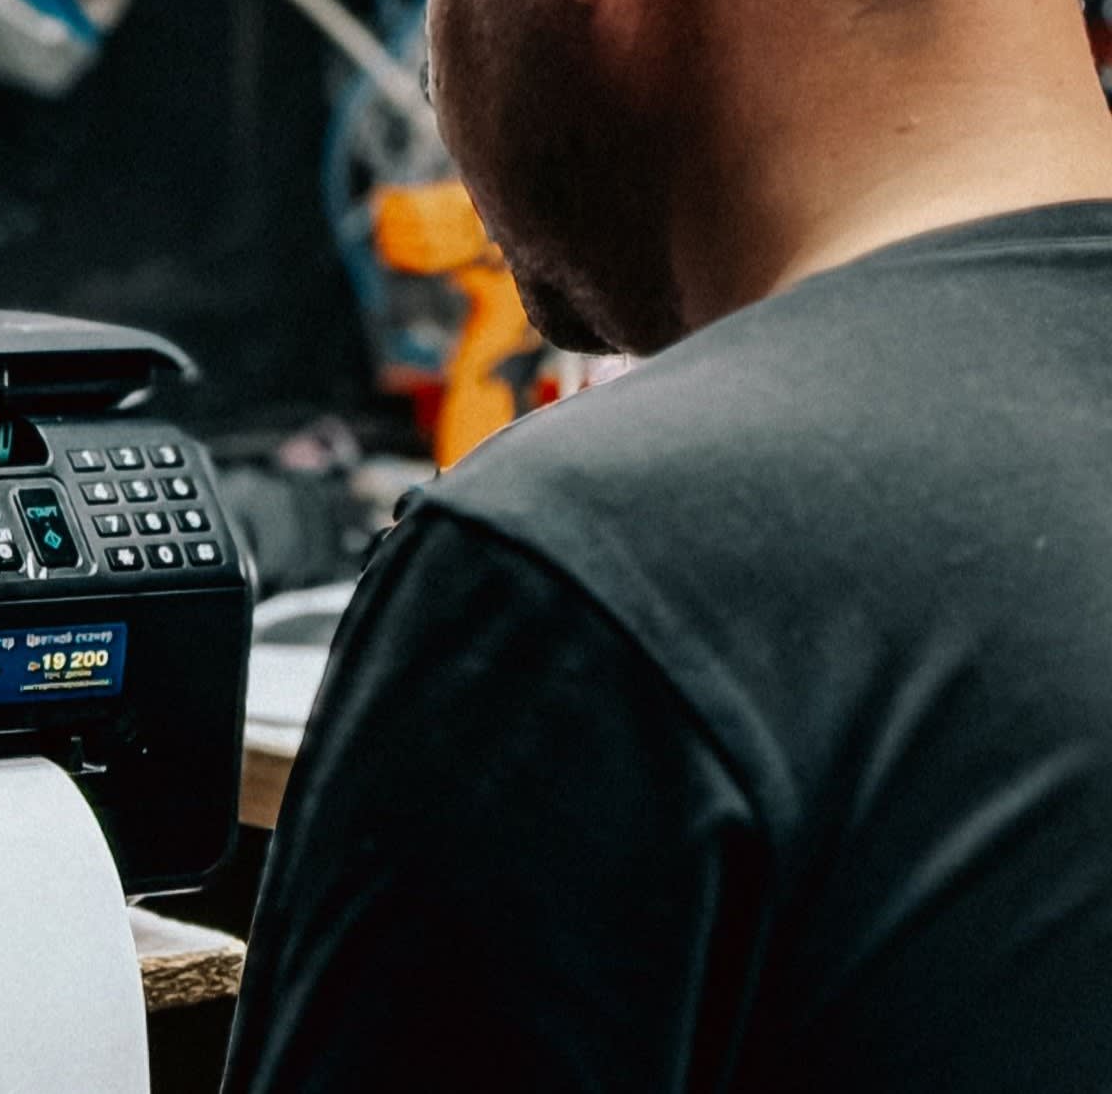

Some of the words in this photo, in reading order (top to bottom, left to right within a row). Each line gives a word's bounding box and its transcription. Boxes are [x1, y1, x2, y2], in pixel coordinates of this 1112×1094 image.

[81, 451, 94, 467] 1
[120, 448, 137, 466] 2
[159, 446, 177, 464] 3
[94, 483, 108, 500] 4
[132, 481, 148, 498] 5
[173, 478, 188, 496] 6
[105, 515, 118, 533] 7
[186, 510, 202, 528] 9
[158, 545, 174, 563] 0
[26, 631, 72, 648] Цветной
[42, 651, 67, 670] 19
[70, 649, 109, 669] 200
